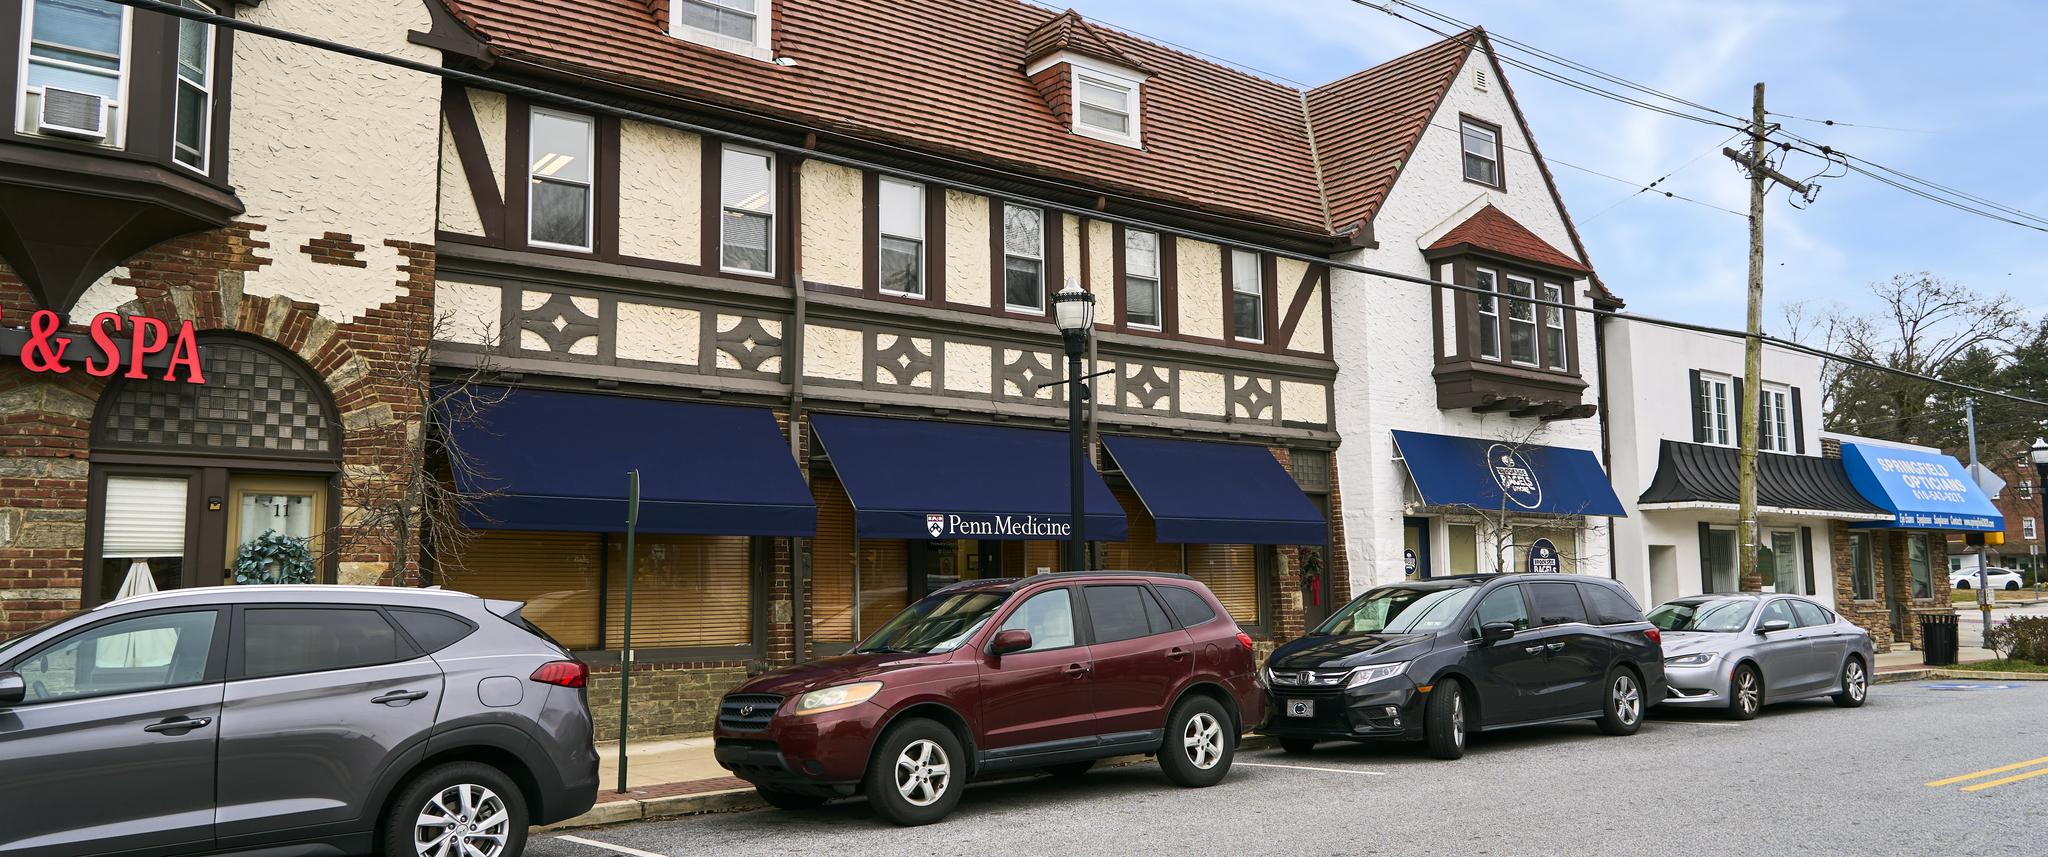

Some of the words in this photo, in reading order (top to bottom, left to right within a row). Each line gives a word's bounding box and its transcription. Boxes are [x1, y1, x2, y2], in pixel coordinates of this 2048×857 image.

[20, 309, 72, 374] &
[85, 312, 206, 384] SPA
[1877, 457, 1949, 477] SPRINGFIELD
[1902, 474, 1967, 493] OPTICIANS
[1912, 489, 1965, 503] 610-543-9275
[273, 503, 290, 517] 11
[948, 514, 993, 535] Penn
[994, 515, 1071, 536] Medicine
